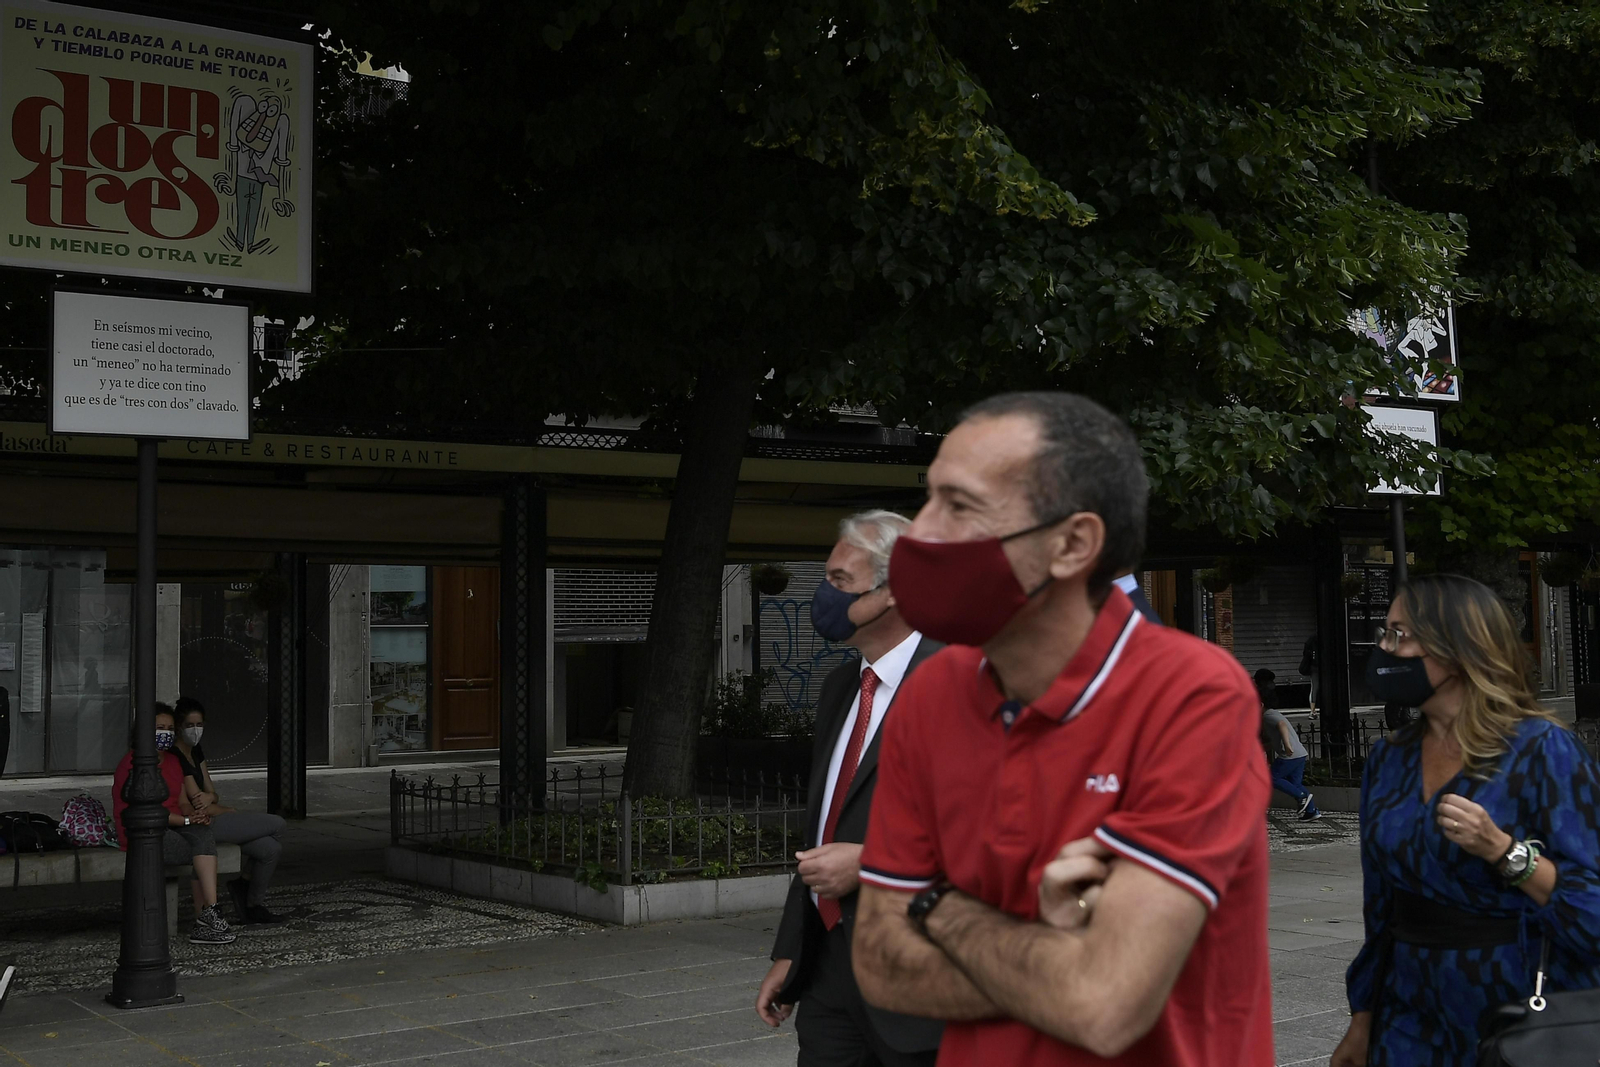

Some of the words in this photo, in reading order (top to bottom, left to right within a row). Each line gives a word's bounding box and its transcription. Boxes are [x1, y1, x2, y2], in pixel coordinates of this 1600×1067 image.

[14, 16, 37, 31] DE
[44, 21, 67, 36] LA
[73, 25, 165, 49] CALABAZA
[171, 40, 184, 52] A
[188, 42, 209, 56] LA
[214, 46, 288, 70] GRANADA
[33, 37, 45, 49] Y
[51, 38, 125, 61] TIEMBLO
[130, 51, 195, 71] PORQUE
[200, 61, 222, 75] ME
[228, 65, 270, 83] TOCA
[8, 234, 41, 250] UN
[50, 238, 130, 257] MENEO
[137, 245, 197, 264] OTRA
[203, 252, 243, 268] VEZ
[94, 319, 109, 332] En
[112, 321, 156, 335] seísmos
[158, 324, 173, 336] mi
[175, 326, 213, 341] vecino,
[91, 339, 119, 351] tiene
[121, 341, 143, 352] casi
[145, 341, 155, 353] el
[158, 342, 215, 358] doctorado,
[73, 357, 88, 367] un
[91, 356, 140, 370] “meneo”
[142, 362, 157, 372] no
[159, 360, 173, 373] ha
[175, 362, 231, 376] terminado
[99, 378, 106, 390] y
[109, 379, 122, 390] ya
[124, 378, 135, 389] te
[137, 377, 160, 390] dice
[162, 382, 182, 391] con
[185, 381, 207, 393] tino
[64, 394, 86, 408] que
[88, 396, 101, 405] es
[103, 394, 117, 406] de
[119, 395, 145, 408] “tres
[147, 398, 167, 409] con
[170, 396, 194, 410] dos”
[196, 399, 239, 413] clavado.
[264, 442, 275, 457] &
[287, 443, 458, 465] RESTAURANTE
